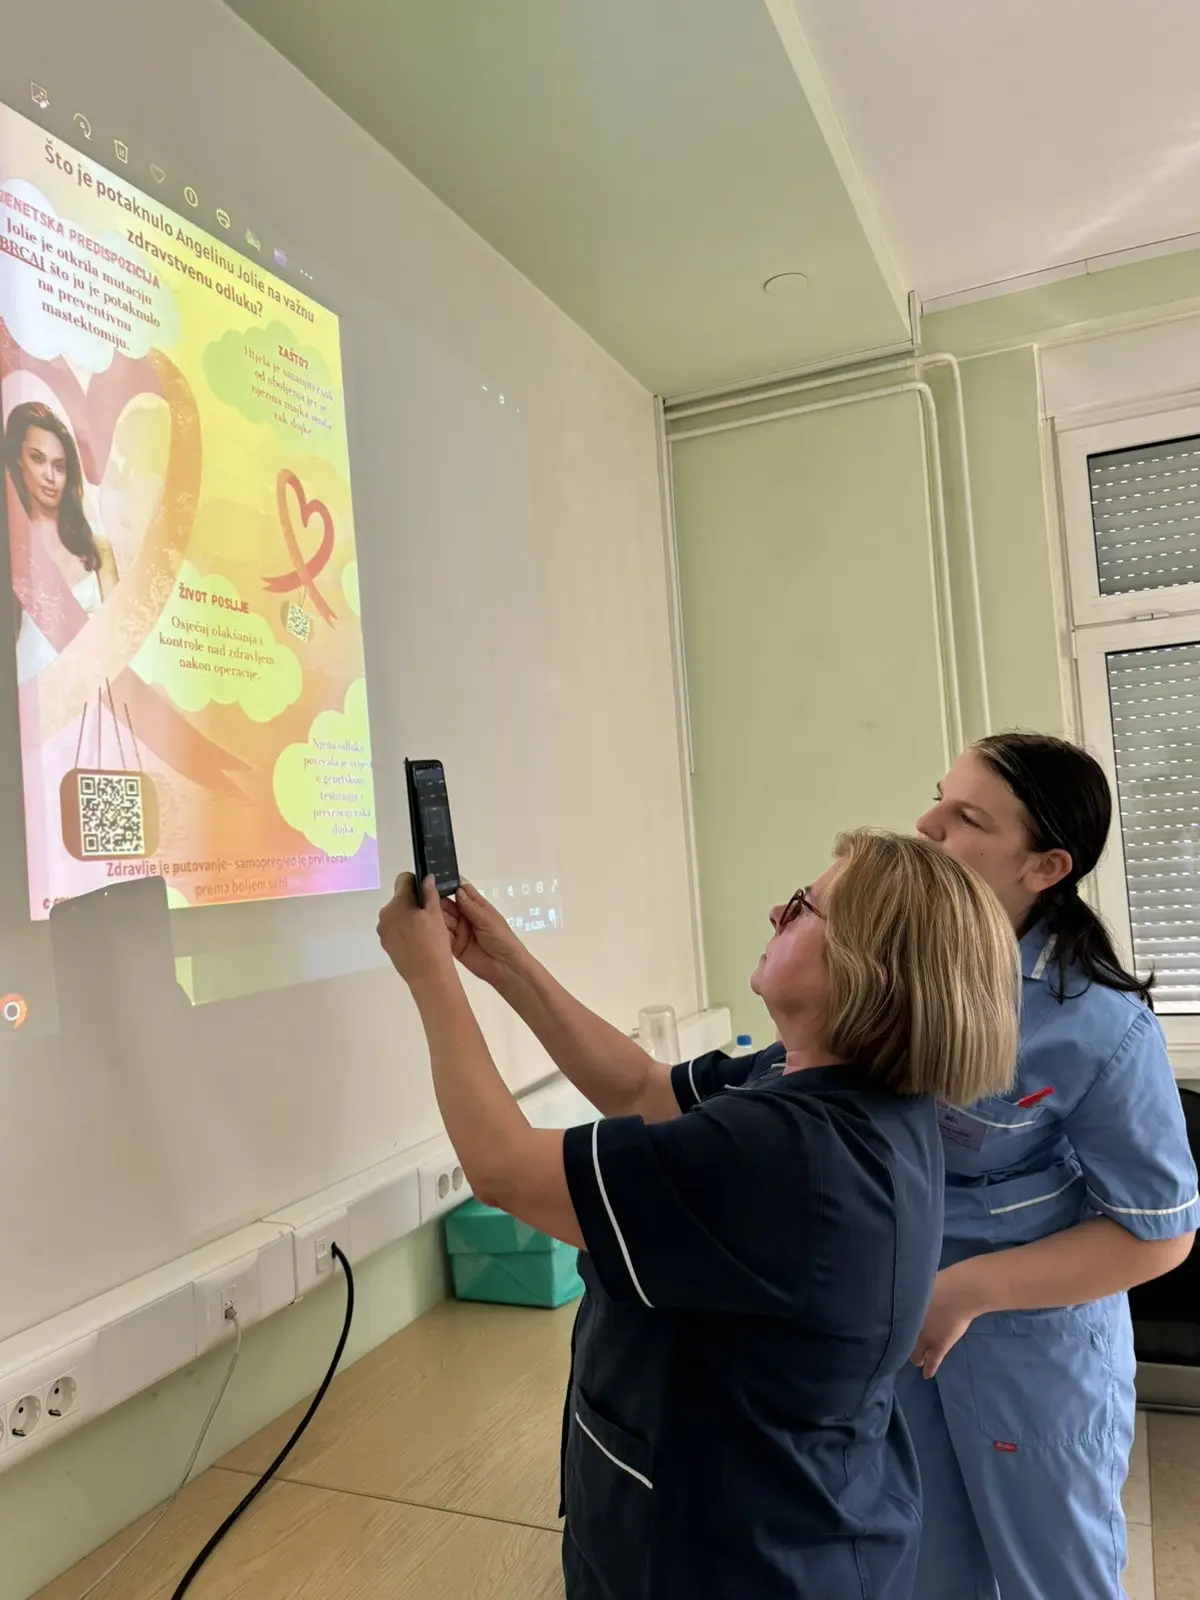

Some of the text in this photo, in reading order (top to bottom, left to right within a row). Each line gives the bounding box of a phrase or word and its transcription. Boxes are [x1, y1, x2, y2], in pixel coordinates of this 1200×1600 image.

[45, 138, 314, 323] Što je potaknulo Angelinu Jolie na važnu
[6, 217, 152, 305] Jolie je otkrila mutaciju
[69, 228, 161, 289] PREDISPOZICIJA
[127, 229, 263, 318] zdravstvenu odluku?
[38, 278, 132, 332] na preventivnu
[50, 260, 69, 281] što
[73, 273, 85, 290] ju
[89, 282, 100, 297] je
[103, 292, 160, 328] potaknulo
[42, 301, 130, 350] mastektomiju.
[278, 344, 309, 370] ZAŠTO?
[178, 582, 207, 603] ŽIVOT
[159, 631, 275, 666] kontrole nad zdravljem
[179, 656, 261, 682] nakon operacije.
[106, 860, 156, 878] Zdravlje
[159, 861, 170, 876] je
[195, 882, 231, 900] prema
[232, 876, 267, 894] boljem
